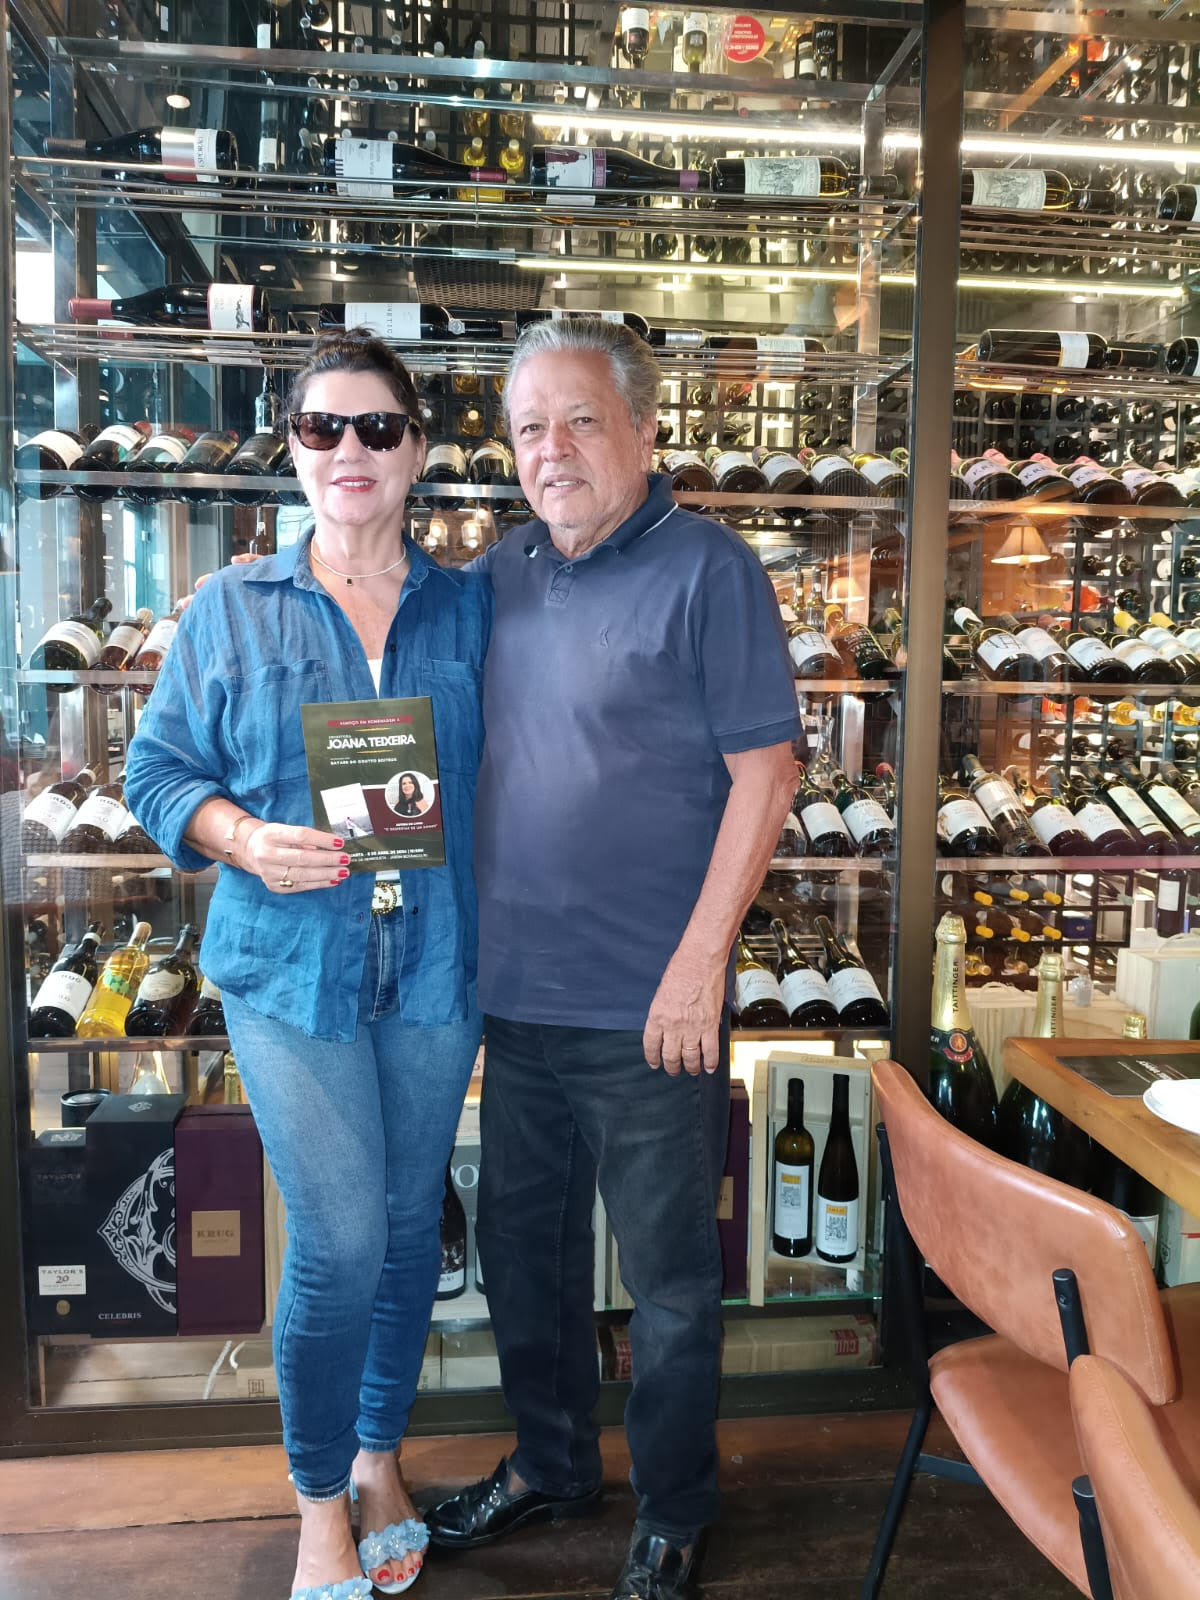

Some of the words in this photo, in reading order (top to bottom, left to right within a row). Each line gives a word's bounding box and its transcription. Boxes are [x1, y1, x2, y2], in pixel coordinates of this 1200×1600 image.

[326, 737, 368, 750] JOANA
[367, 733, 416, 747] TEIXEIRA
[952, 961, 960, 1014] TAITTINGER
[196, 1230, 236, 1239] KRUG
[55, 1275, 70, 1284] 20
[97, 1312, 142, 1320] CELEBRIS
